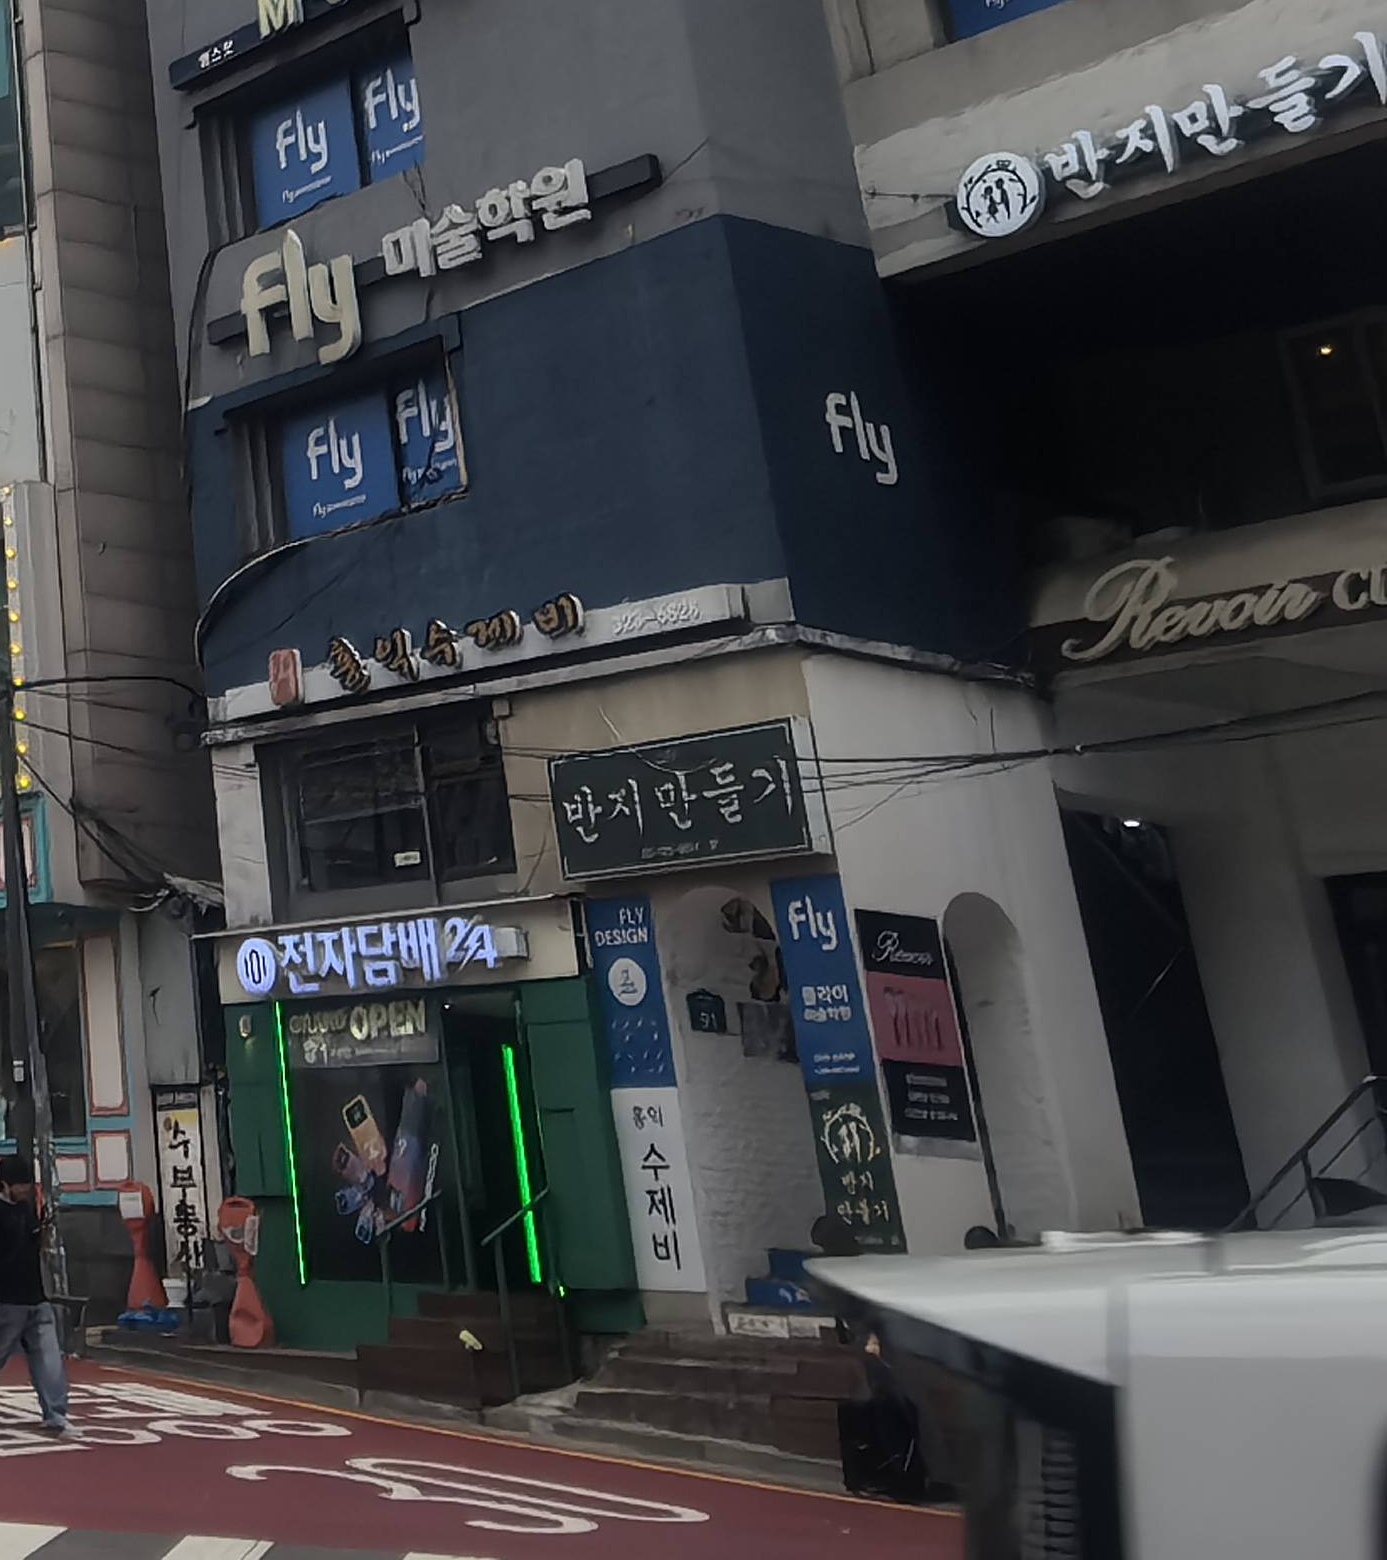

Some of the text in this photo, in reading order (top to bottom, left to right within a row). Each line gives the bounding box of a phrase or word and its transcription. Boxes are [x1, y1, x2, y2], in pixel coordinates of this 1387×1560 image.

[380, 158, 591, 278] 미술학원
[278, 918, 441, 994] 전자담배
[595, 927, 648, 946] DESIGN
[349, 998, 426, 1041] OPEN
[802, 985, 849, 1005] 라이
[641, 1143, 681, 1271] 수제비
